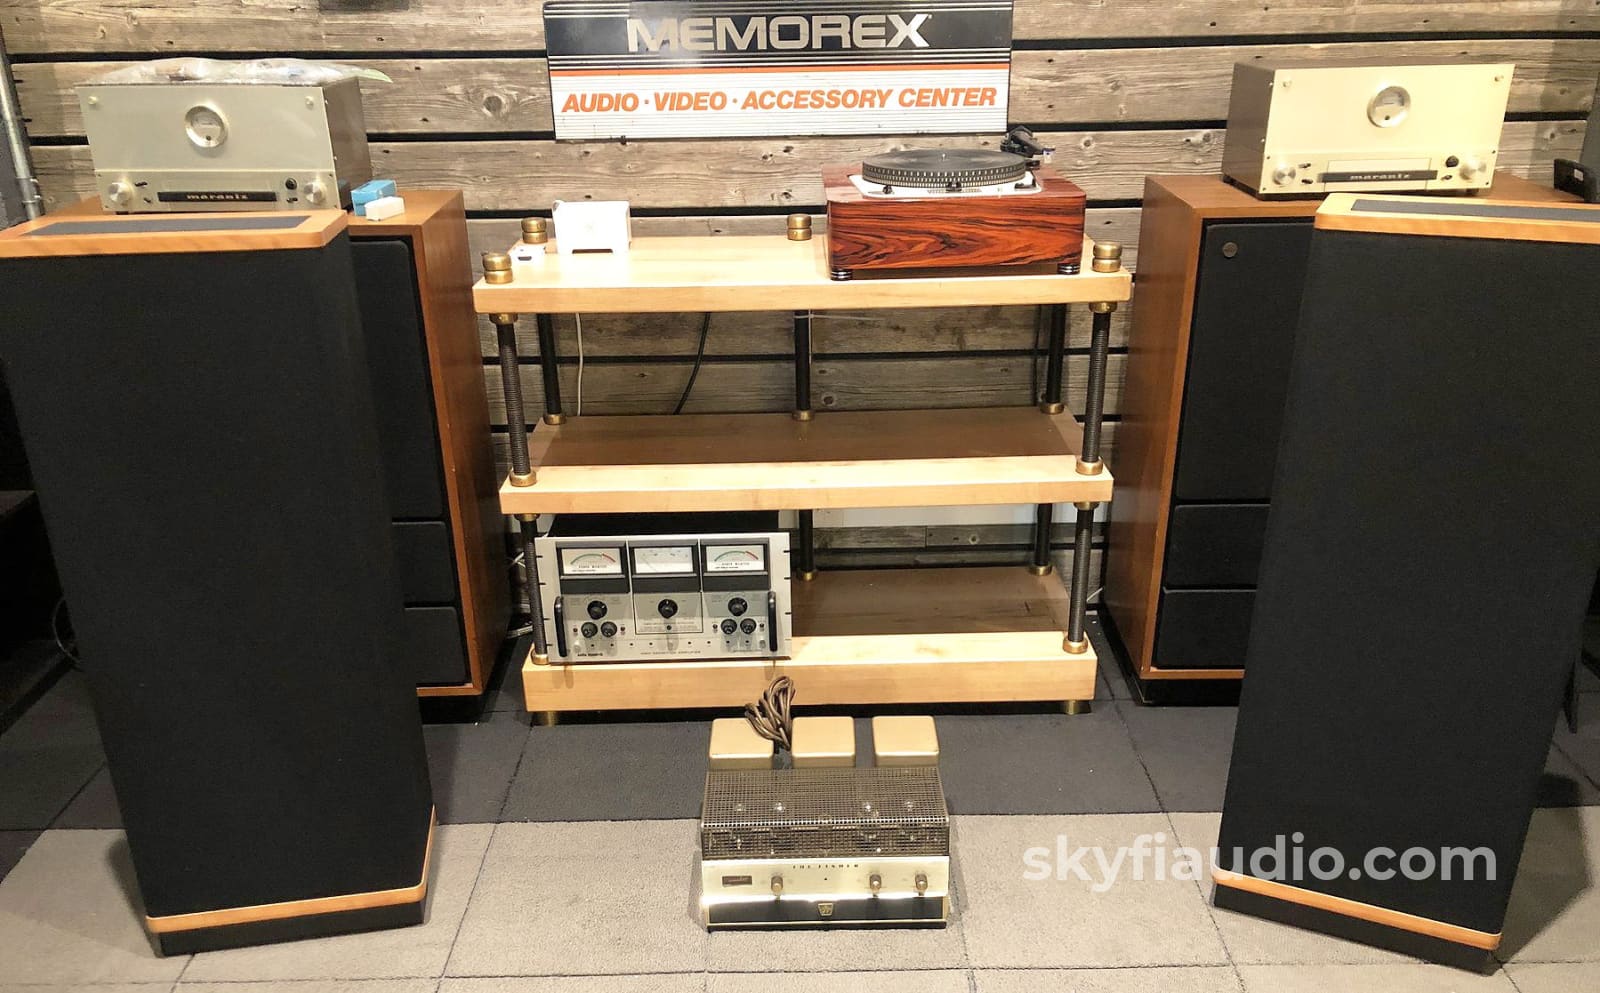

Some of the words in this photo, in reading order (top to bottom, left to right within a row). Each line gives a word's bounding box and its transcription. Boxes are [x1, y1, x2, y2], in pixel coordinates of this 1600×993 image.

[627, 14, 929, 52] MEMOREX
[561, 92, 639, 113] AUDIO
[654, 91, 727, 112] VIDEO
[741, 88, 894, 110] ACCESSORY
[898, 87, 998, 107] CENTER
